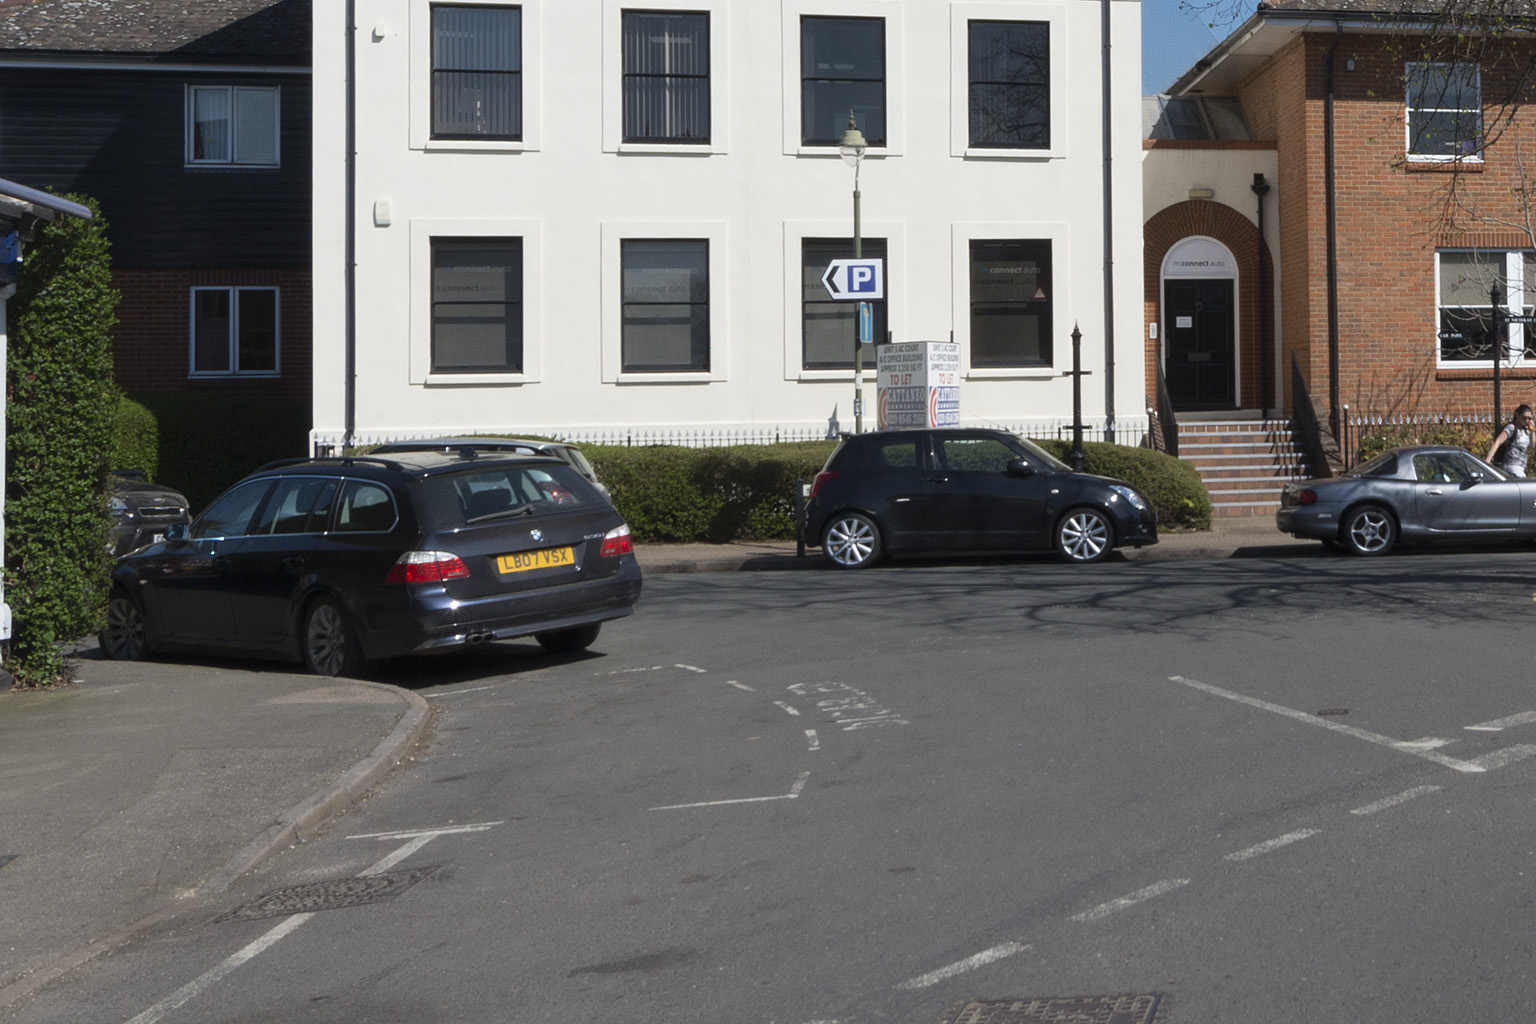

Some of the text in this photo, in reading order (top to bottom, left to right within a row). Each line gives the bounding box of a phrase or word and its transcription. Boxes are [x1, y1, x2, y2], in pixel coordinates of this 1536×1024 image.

[853, 267, 872, 291] P
[905, 344, 919, 352] COURT
[890, 373, 913, 386] TO LET
[939, 373, 946, 385] TO
[503, 549, 568, 570] LB07 VSX
